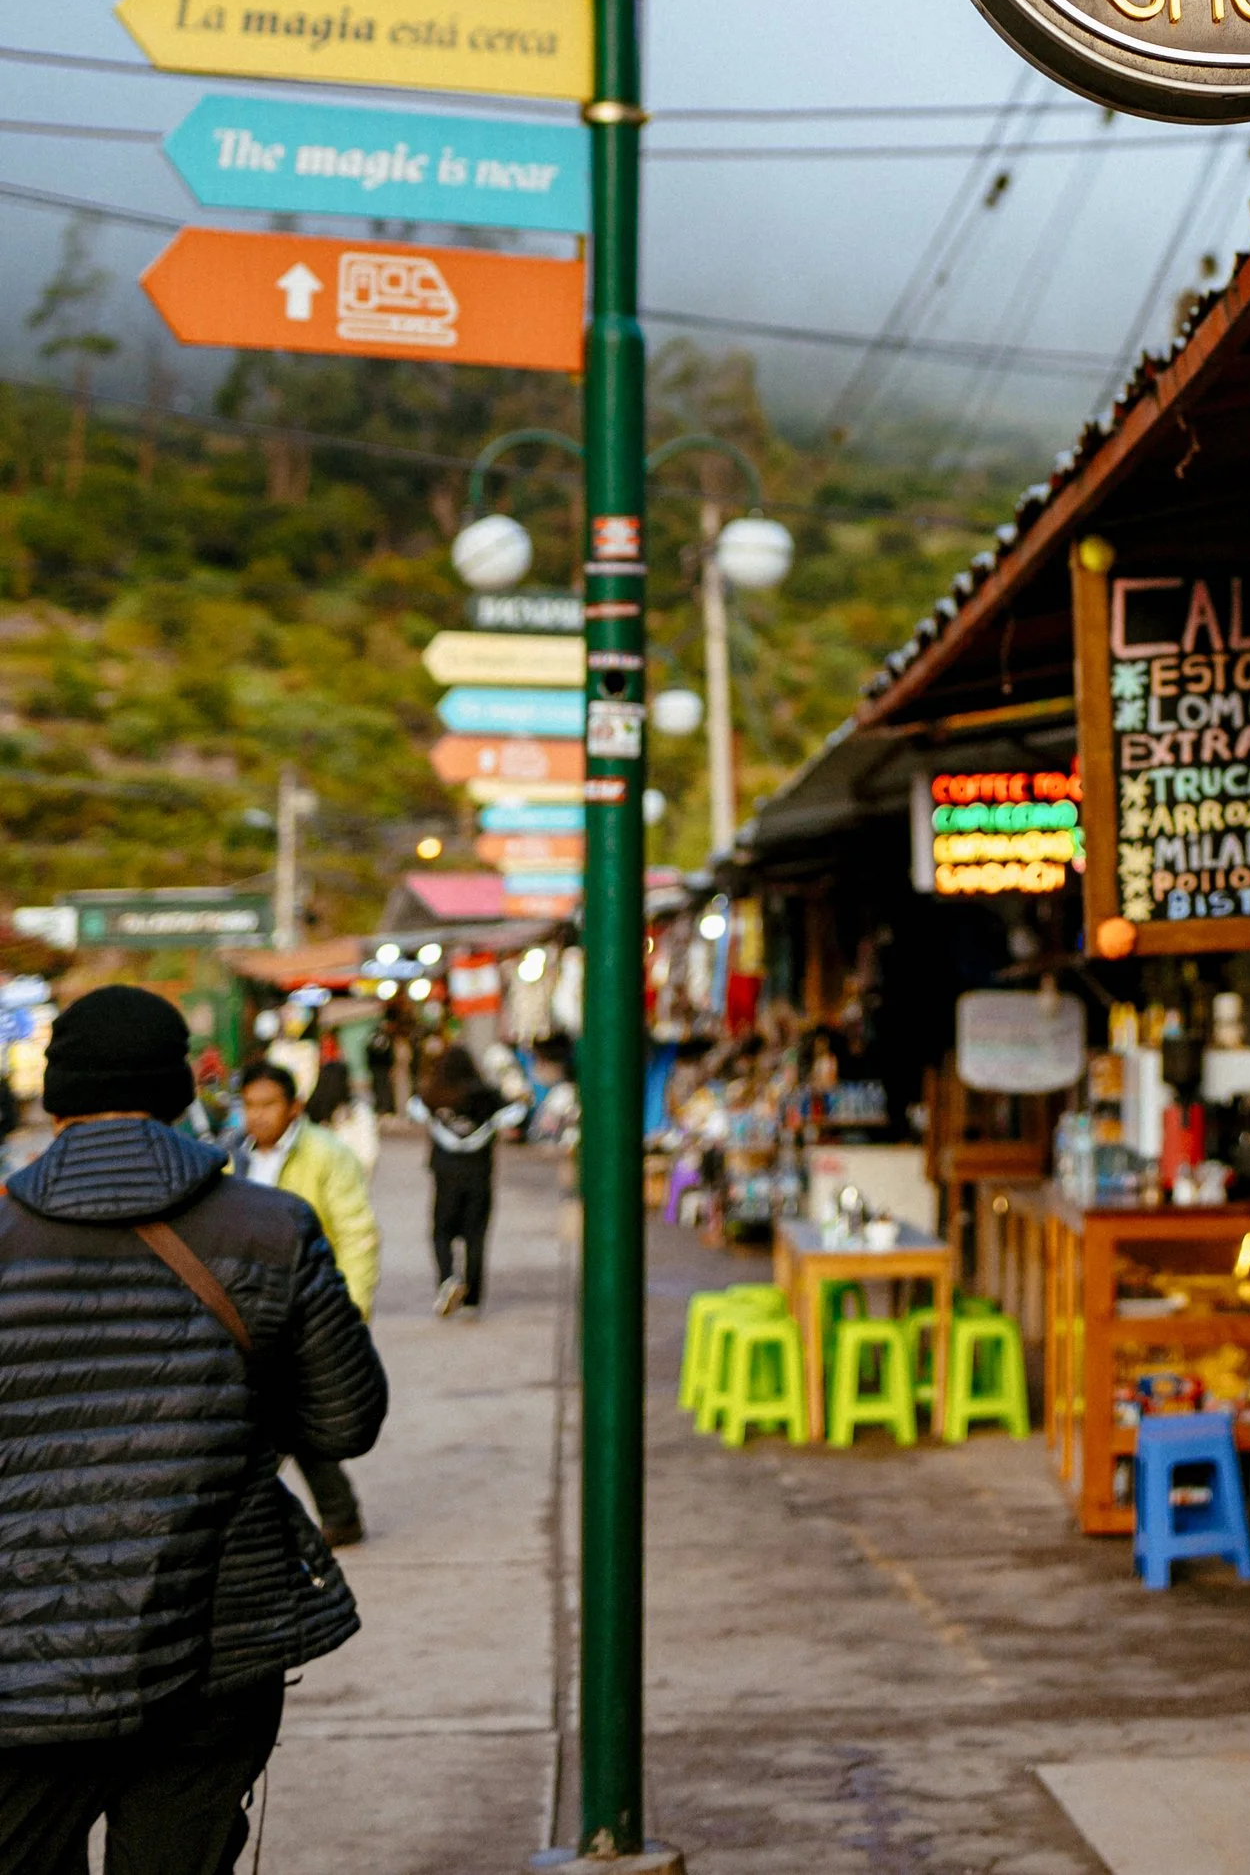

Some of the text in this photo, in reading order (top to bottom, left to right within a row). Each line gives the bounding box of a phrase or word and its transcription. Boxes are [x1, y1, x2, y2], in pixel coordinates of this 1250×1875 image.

[240, 5, 376, 52] magia
[386, 18, 460, 51] está
[465, 27, 558, 58] cerca
[211, 127, 560, 193] The magic is near
